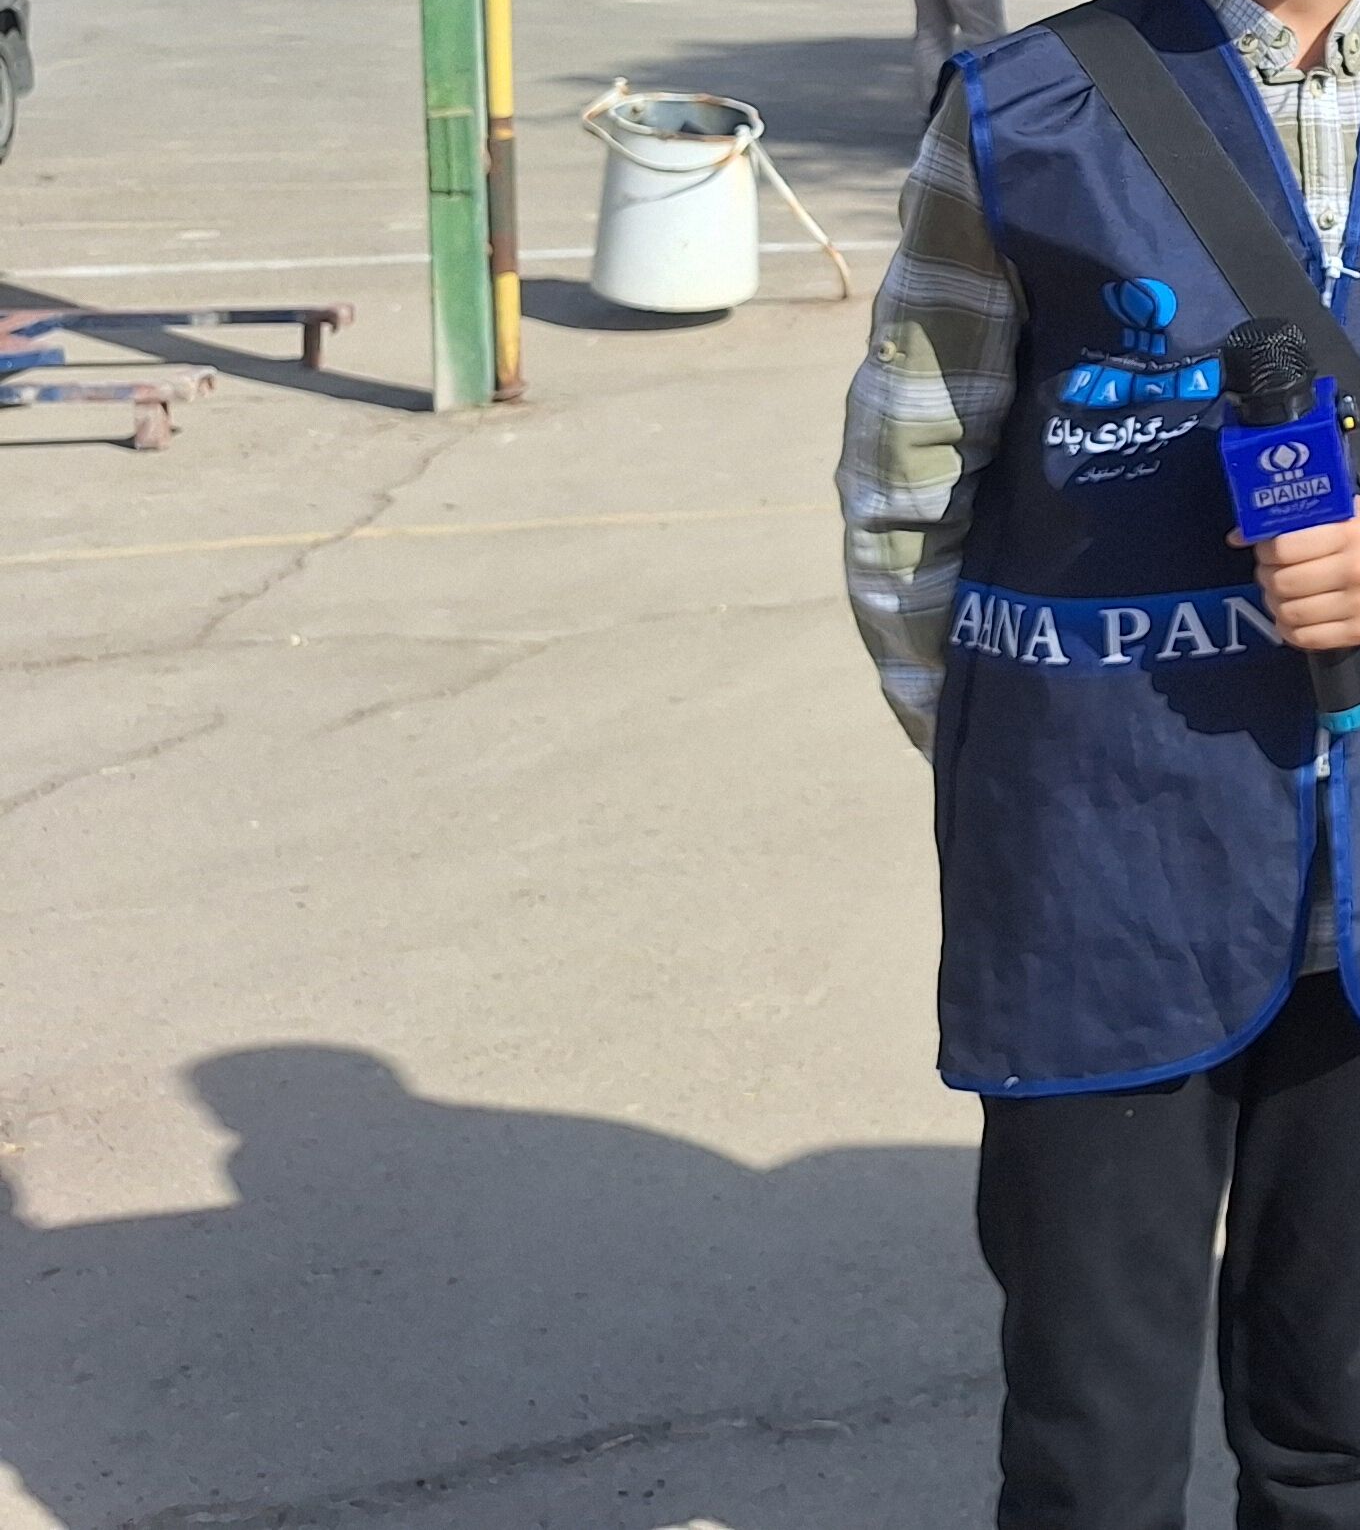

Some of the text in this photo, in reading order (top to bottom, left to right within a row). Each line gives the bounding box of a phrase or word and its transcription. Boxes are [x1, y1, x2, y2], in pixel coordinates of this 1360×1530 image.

[1065, 366, 1213, 405] PANA
[1047, 414, 1200, 456] خبرگزاری پانا
[1258, 479, 1329, 506] PANA
